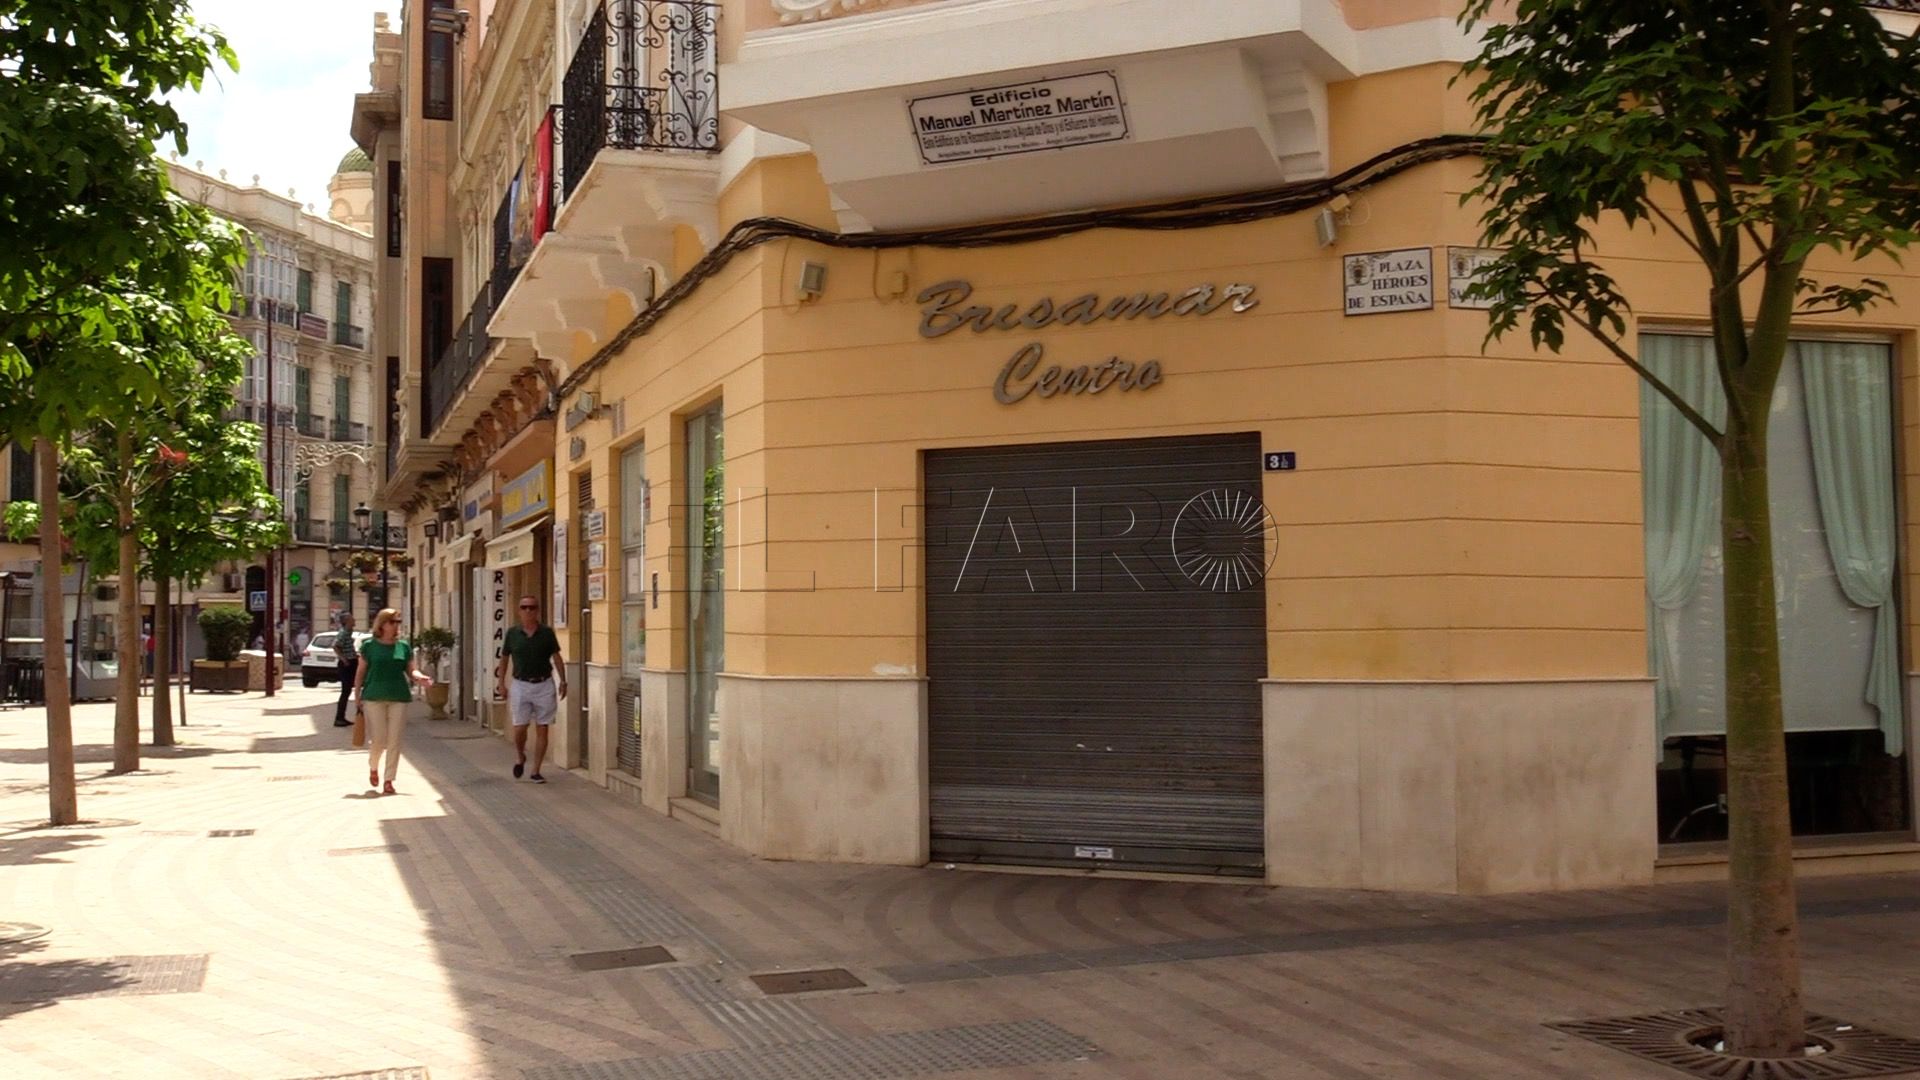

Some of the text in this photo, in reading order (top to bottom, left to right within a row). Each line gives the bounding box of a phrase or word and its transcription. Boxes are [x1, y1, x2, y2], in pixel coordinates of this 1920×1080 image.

[970, 88, 1051, 106] Edificio
[920, 91, 1114, 131] Manuel Martínez Martín
[1379, 260, 1424, 273] PLAZA
[1349, 291, 1427, 309] DE ESPAÑA
[993, 342, 1164, 406] Centro
[1270, 455, 1280, 469] 3
